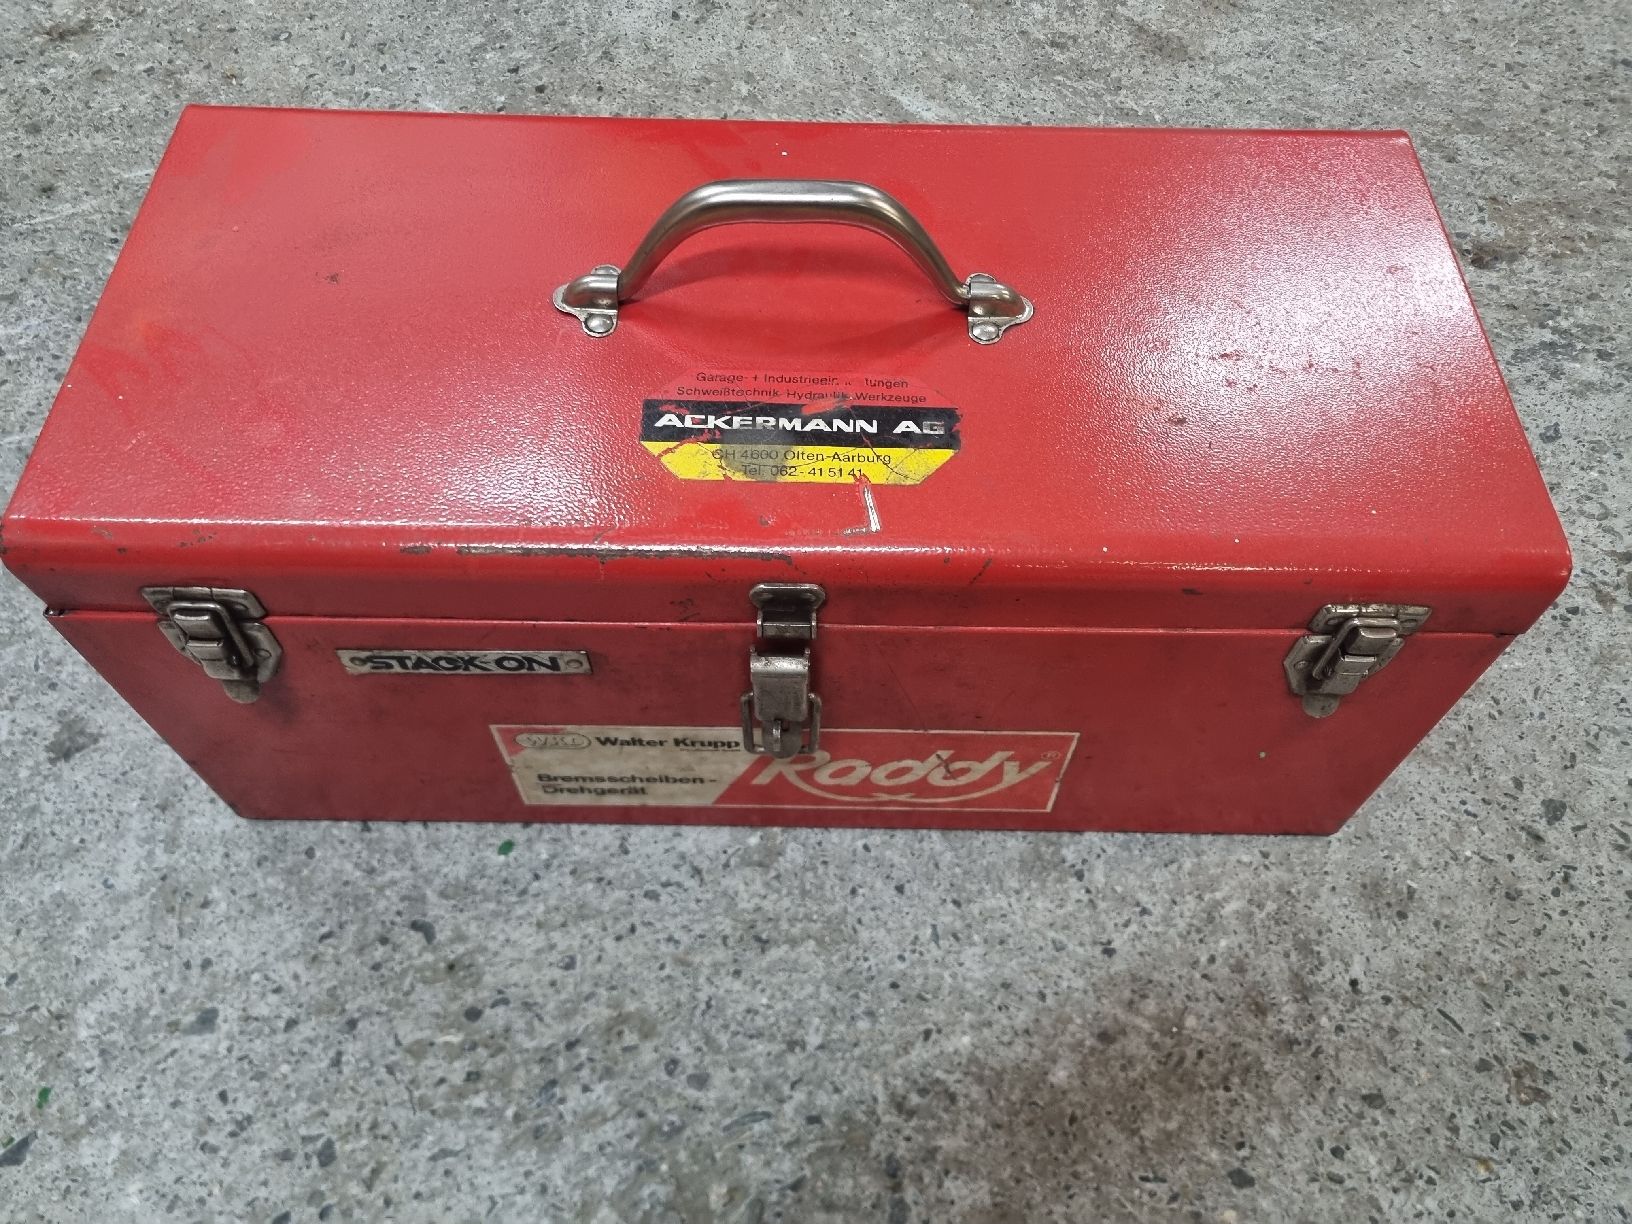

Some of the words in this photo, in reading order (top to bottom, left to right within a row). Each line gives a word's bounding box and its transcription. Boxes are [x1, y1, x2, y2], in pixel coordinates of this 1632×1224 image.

[653, 412, 878, 434] ACKERMANN
[892, 419, 945, 435] AG
[711, 449, 736, 460] CH
[741, 449, 779, 460] 4600
[366, 654, 561, 672] STACK-ON
[594, 736, 668, 747] Walter
[673, 737, 741, 749] Krupp
